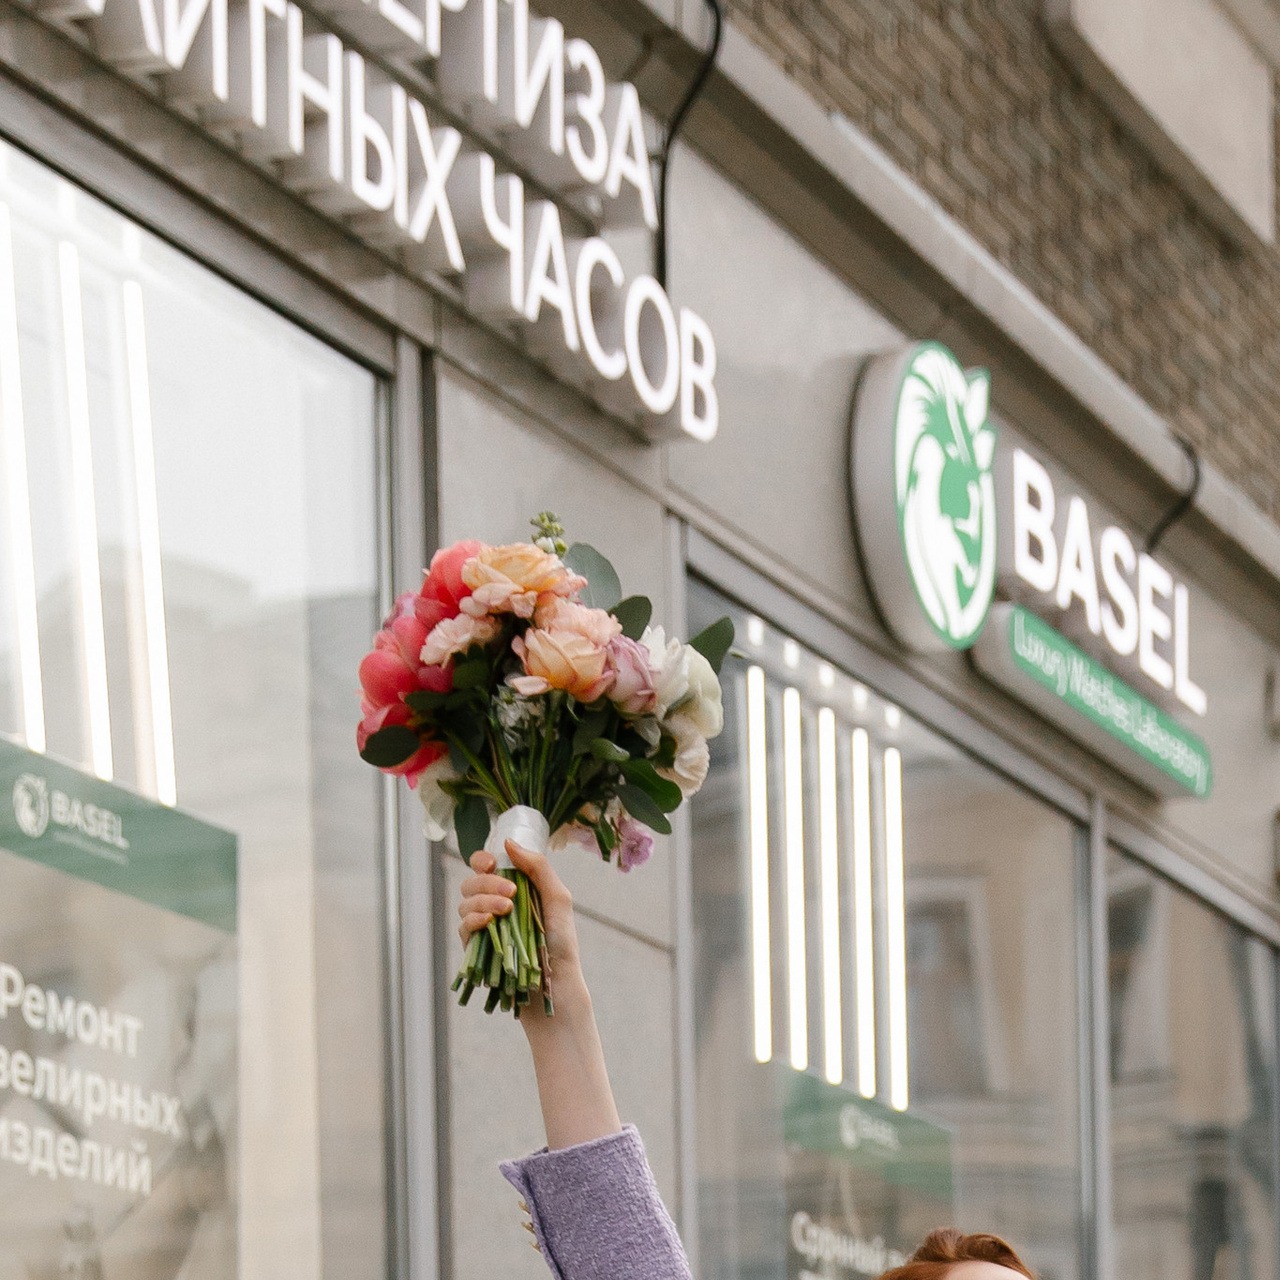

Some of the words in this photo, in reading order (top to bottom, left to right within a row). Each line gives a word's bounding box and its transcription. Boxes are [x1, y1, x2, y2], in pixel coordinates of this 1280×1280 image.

[478, 152, 718, 442] ЧАСОВ
[1012, 447, 1207, 717] BASEL
[51, 789, 130, 850] BASEL
[0, 961, 143, 1058] Ремонт
